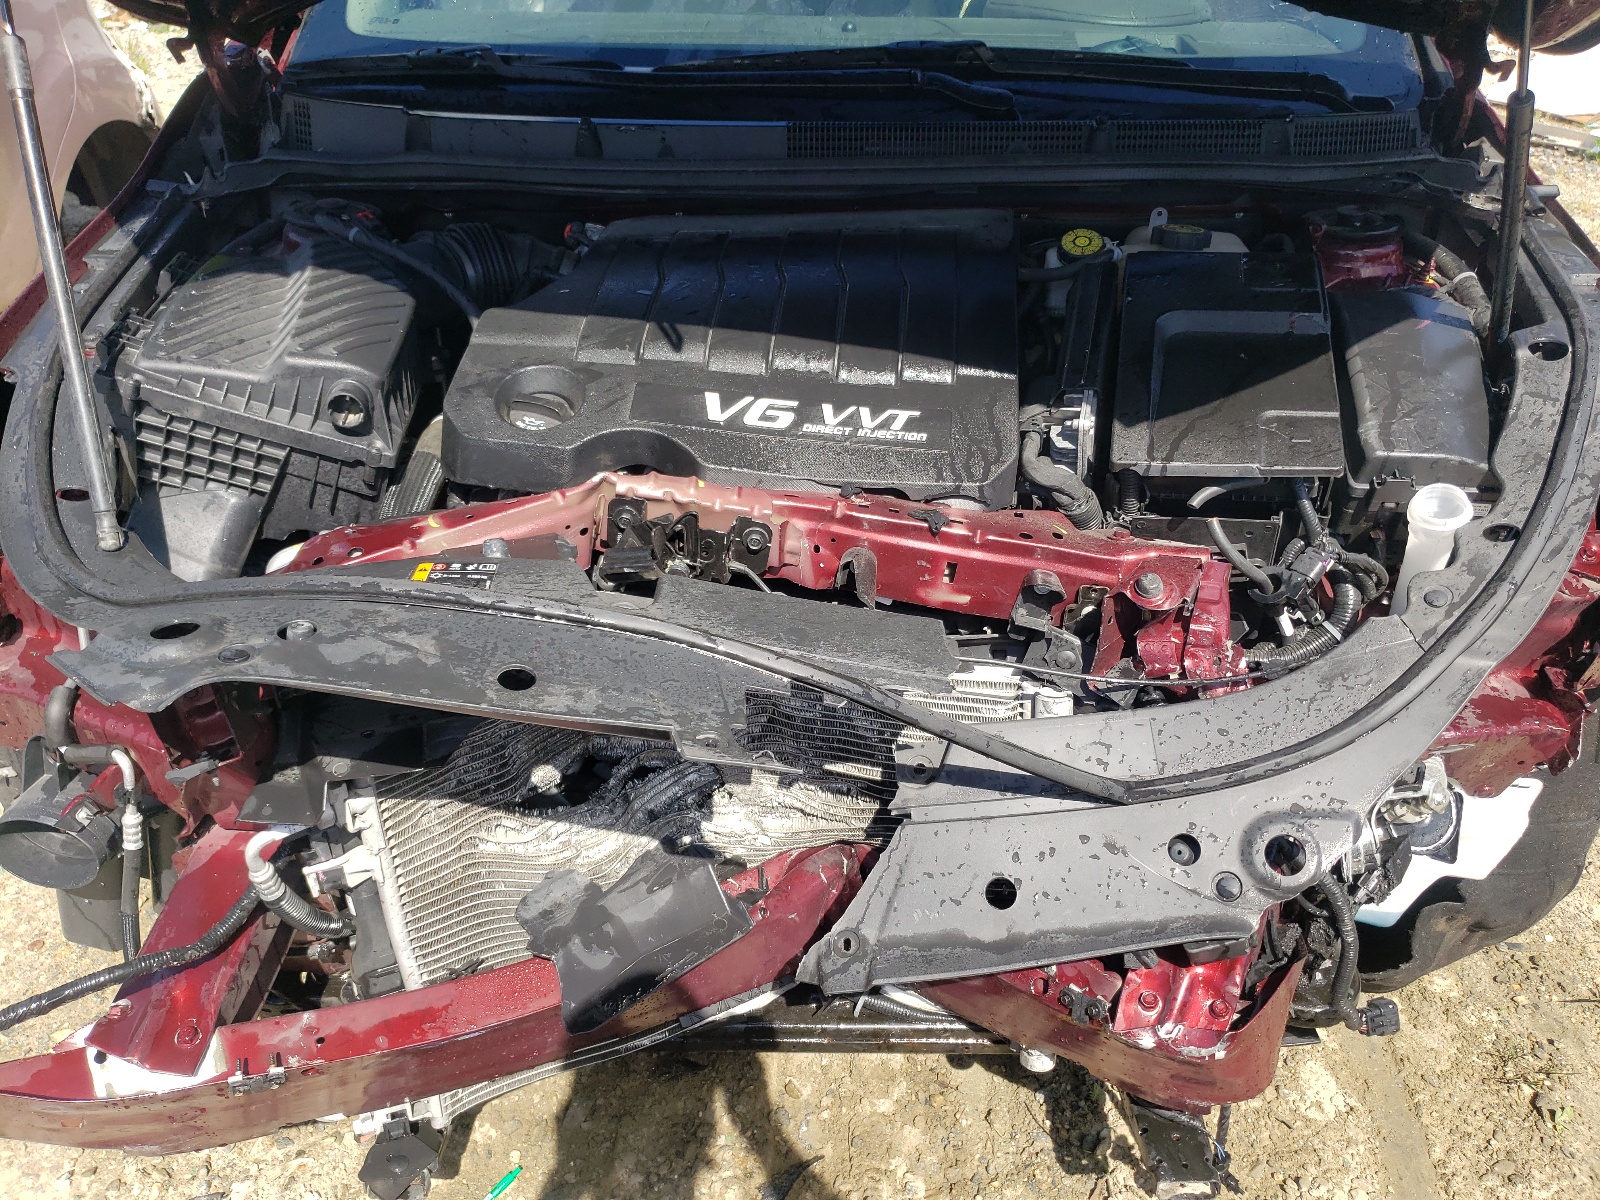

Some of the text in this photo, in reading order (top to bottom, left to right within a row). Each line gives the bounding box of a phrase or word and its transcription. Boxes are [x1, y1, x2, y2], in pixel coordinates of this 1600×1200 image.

[704, 391, 922, 431] V6 VVT
[802, 423, 928, 442] DIRECT INJECTION
